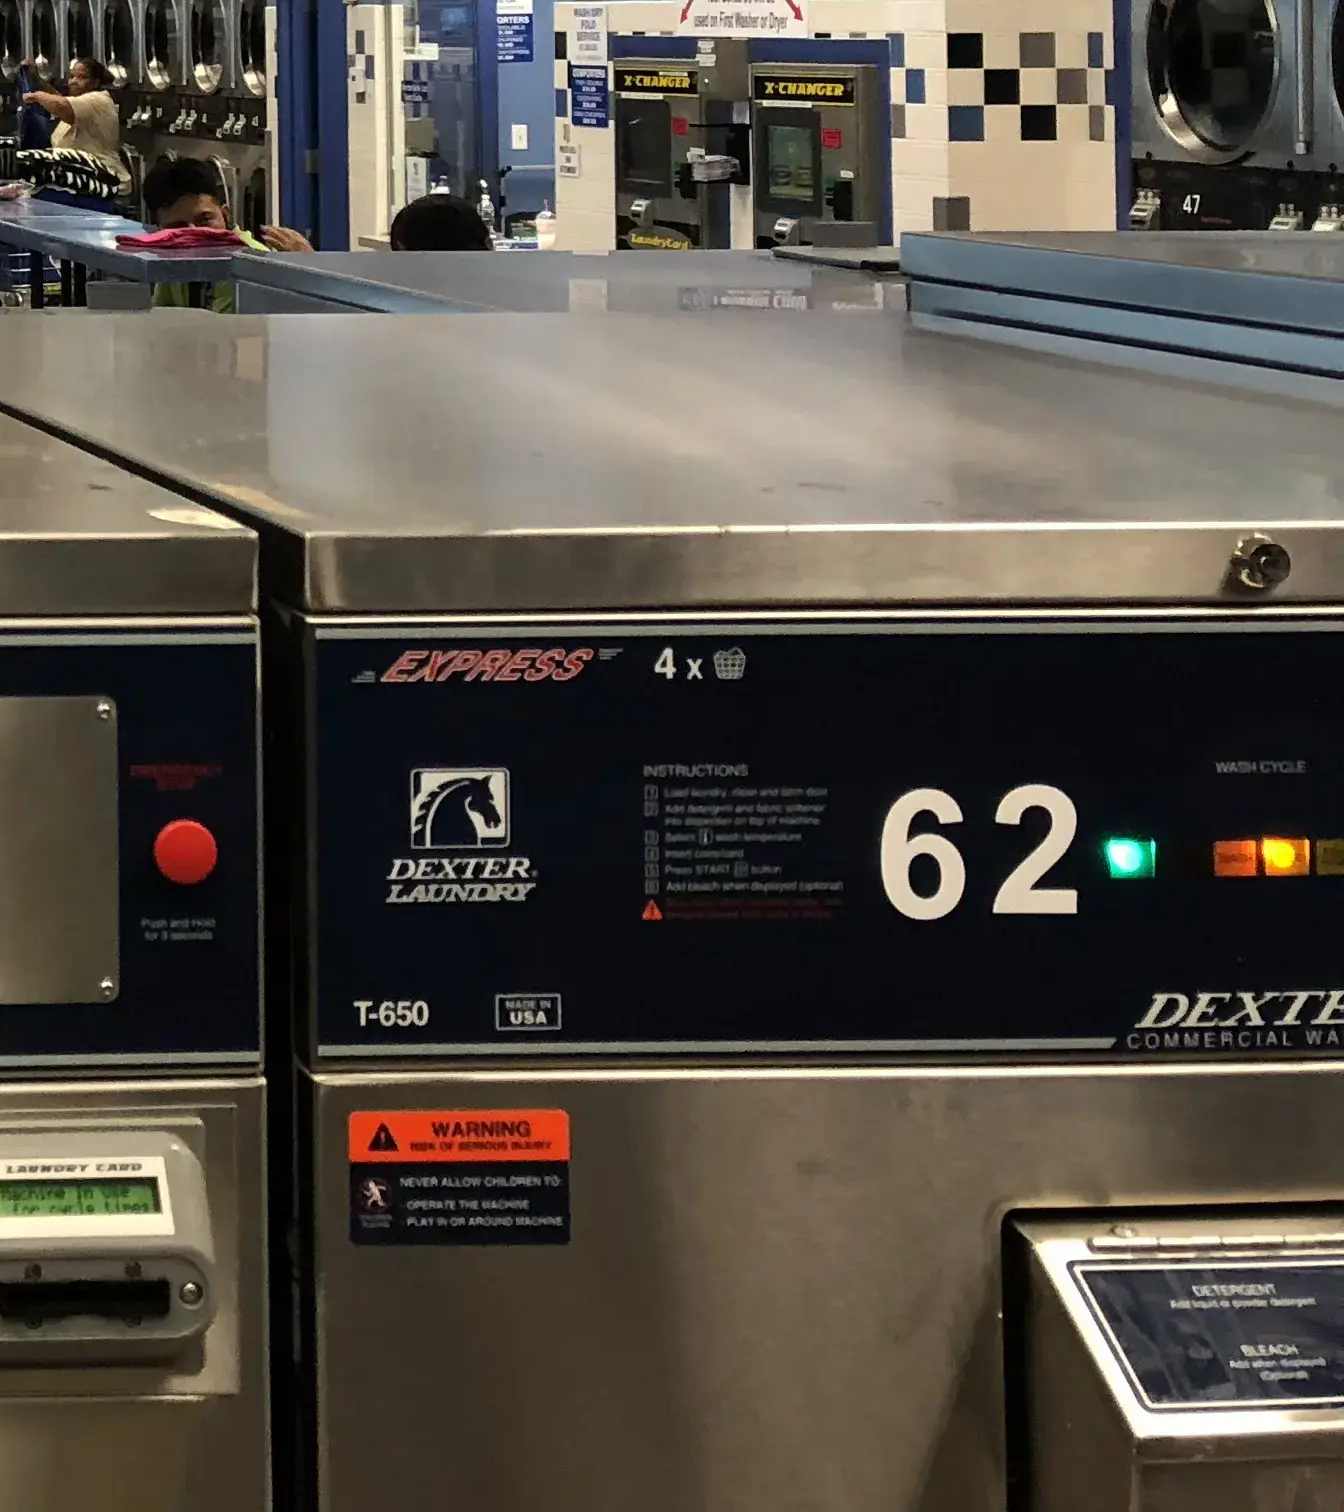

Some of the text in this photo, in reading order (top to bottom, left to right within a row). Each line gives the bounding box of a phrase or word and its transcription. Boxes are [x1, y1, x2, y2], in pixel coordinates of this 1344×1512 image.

[693, 11, 789, 33] used on First Washer or Dryer
[763, 81, 845, 97] X-CHANGER
[1182, 194, 1201, 215] 47
[380, 648, 595, 683] EXPRESS
[653, 646, 704, 680] 4 x
[643, 763, 749, 778] INSTRUCTIONS
[1214, 760, 1307, 775] WASH CYCLE
[879, 783, 1079, 922] 62
[385, 856, 532, 881] DEXTER
[385, 882, 537, 904] LAUNDRY
[352, 999, 430, 1027] T-650
[509, 1010, 548, 1025] USA
[1126, 1030, 1294, 1050] COMMERCIAL
[431, 1120, 532, 1138] WARNING
[5, 1162, 143, 1174] LAUNDRY CARD
[399, 1176, 439, 1188] NEVER
[441, 1176, 482, 1188] ALLOW
[484, 1176, 542, 1188] CHILDREN
